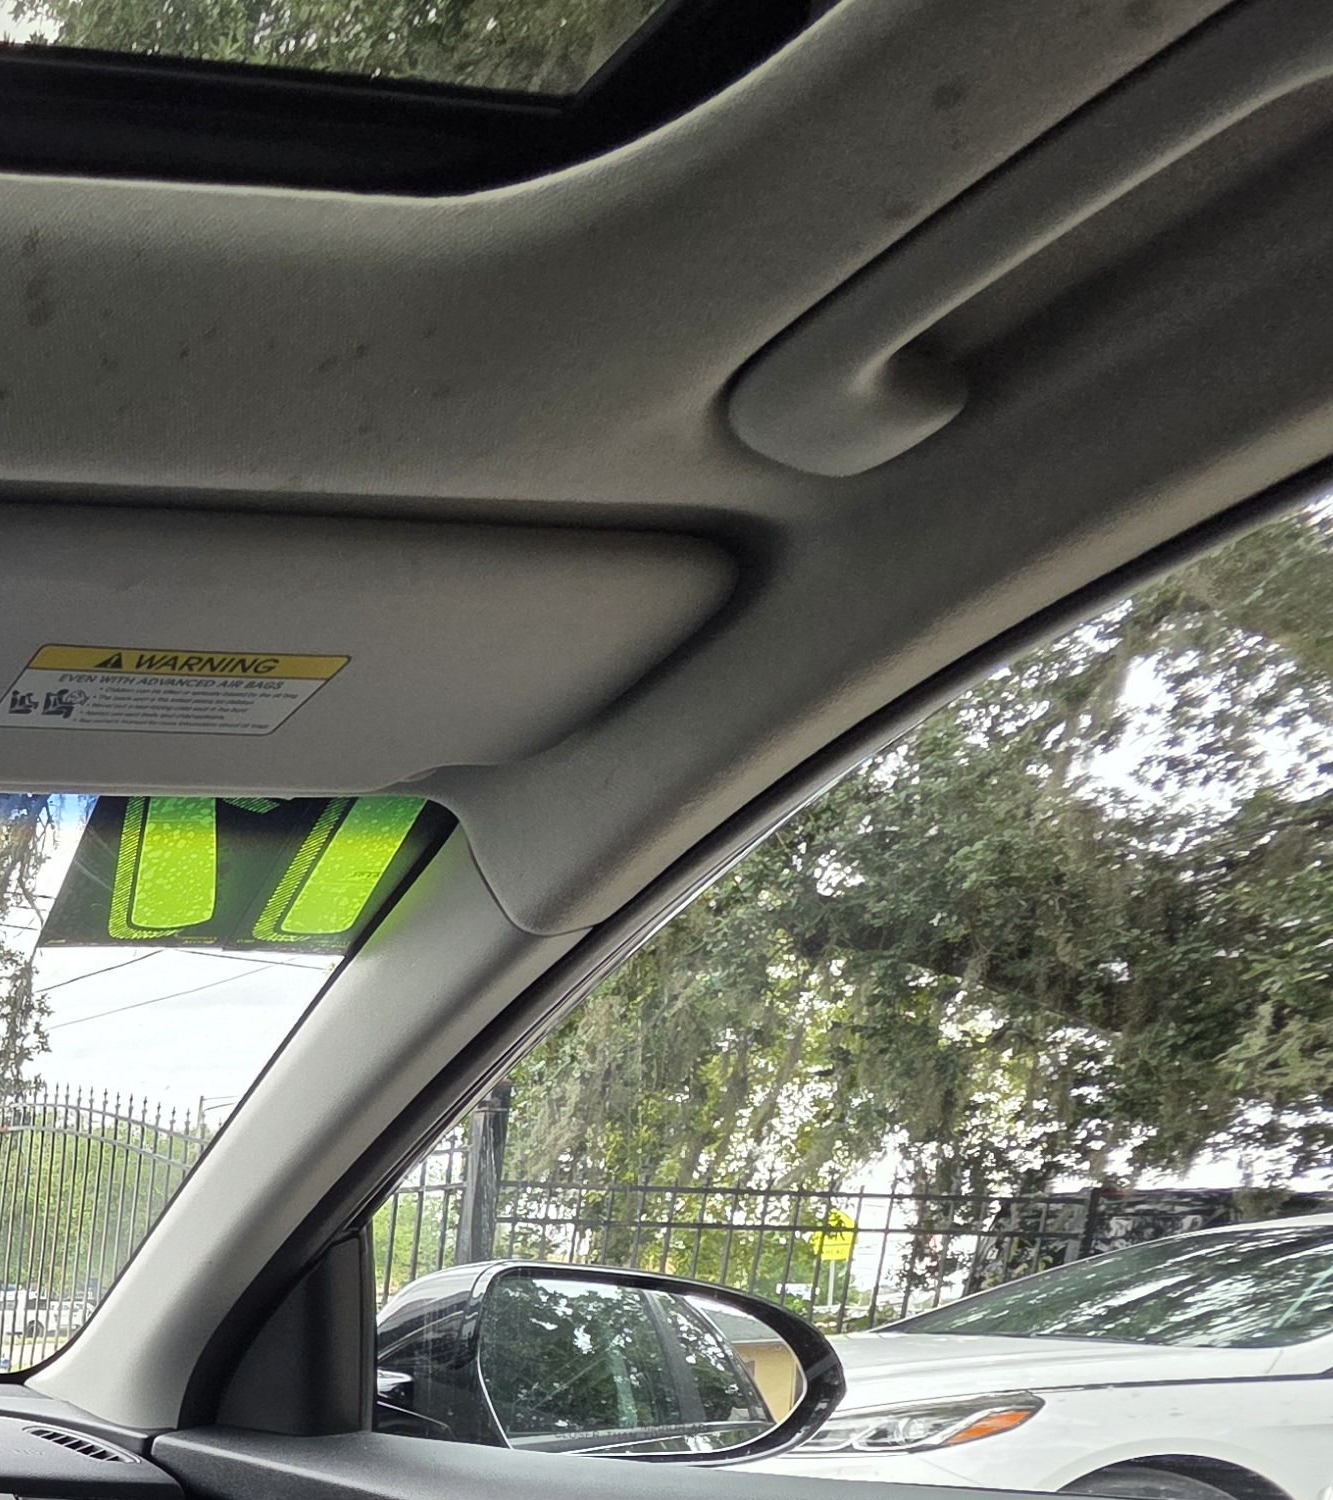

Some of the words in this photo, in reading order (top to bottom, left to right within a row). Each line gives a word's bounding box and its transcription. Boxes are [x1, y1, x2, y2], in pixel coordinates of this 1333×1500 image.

[134, 654, 280, 674] WARNING
[58, 674, 98, 684] EVEN
[99, 675, 137, 685] WITH
[136, 677, 221, 688] ADVANCED
[218, 680, 244, 689] AIR
[244, 681, 285, 690] BAGS
